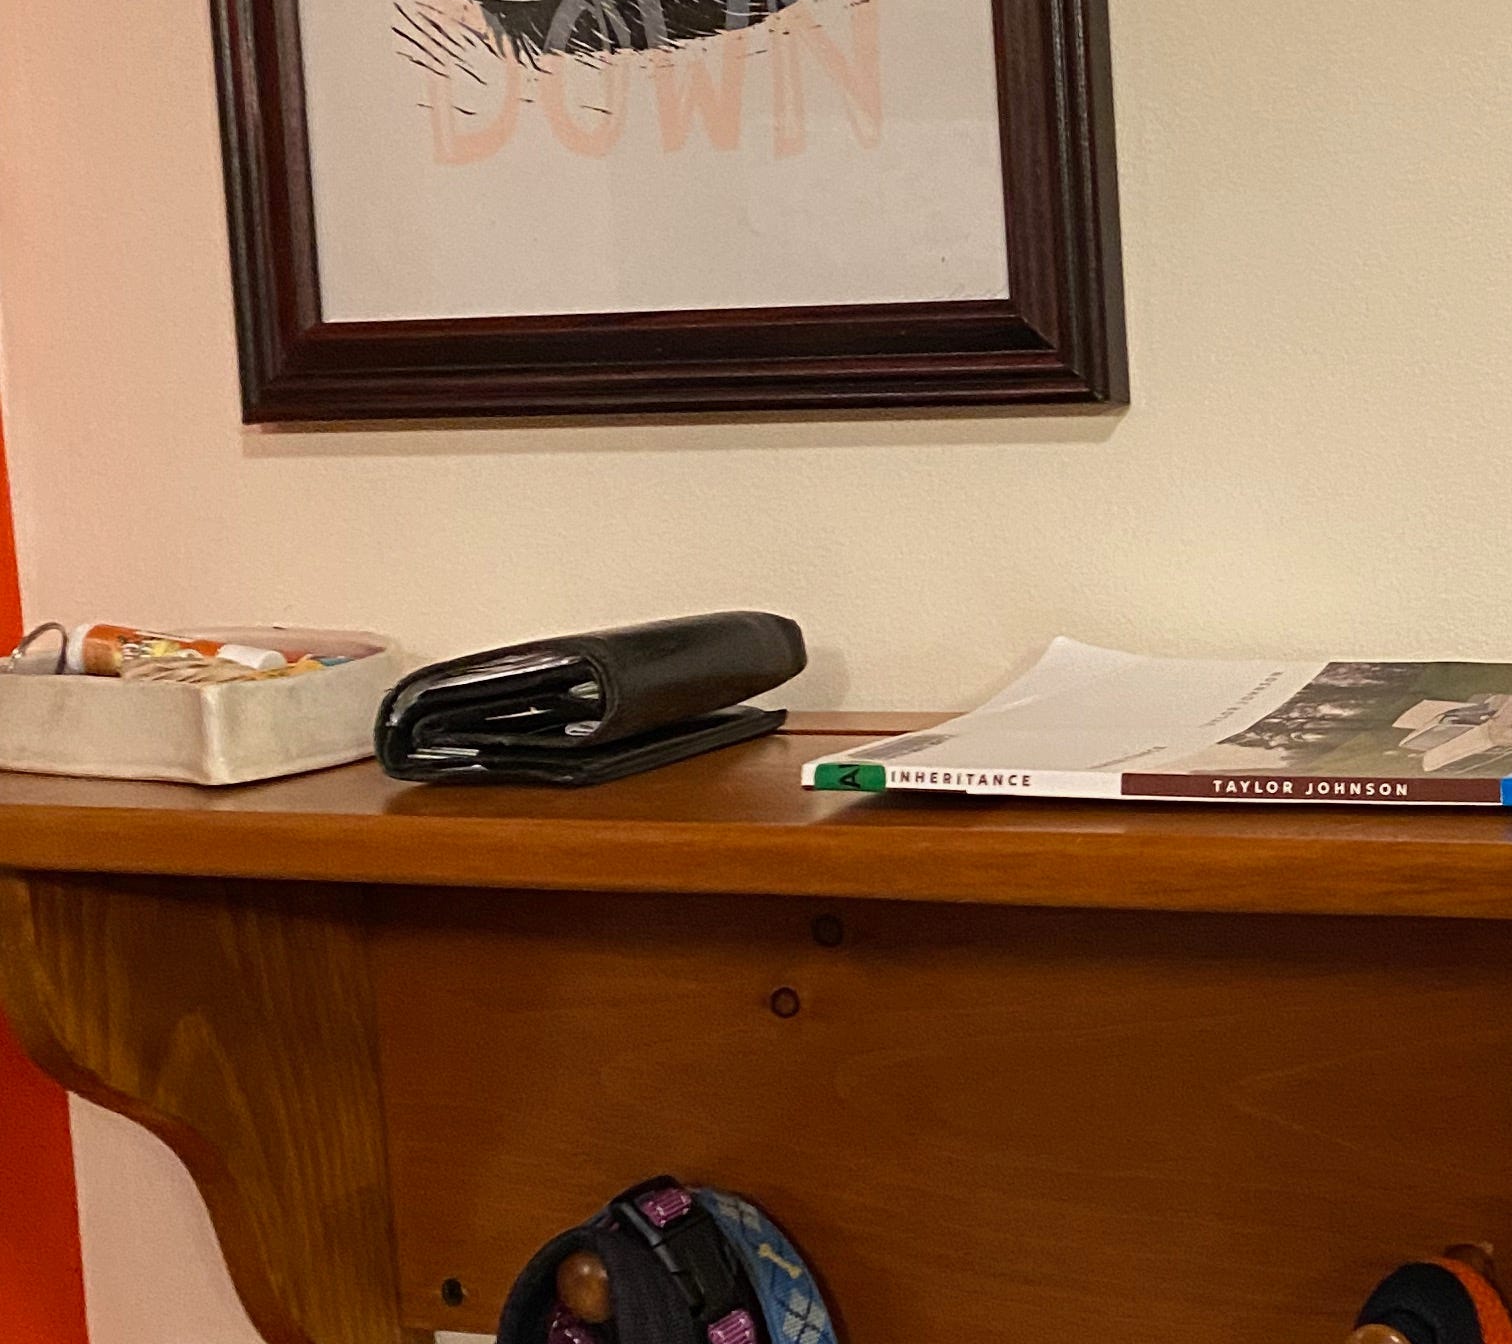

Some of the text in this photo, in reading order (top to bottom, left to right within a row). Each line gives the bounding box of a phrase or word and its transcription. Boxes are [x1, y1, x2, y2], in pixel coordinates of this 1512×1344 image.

[890, 770, 1032, 787] INHERITANCE
[1212, 780, 1408, 796] TAYLOR JOHNSON
